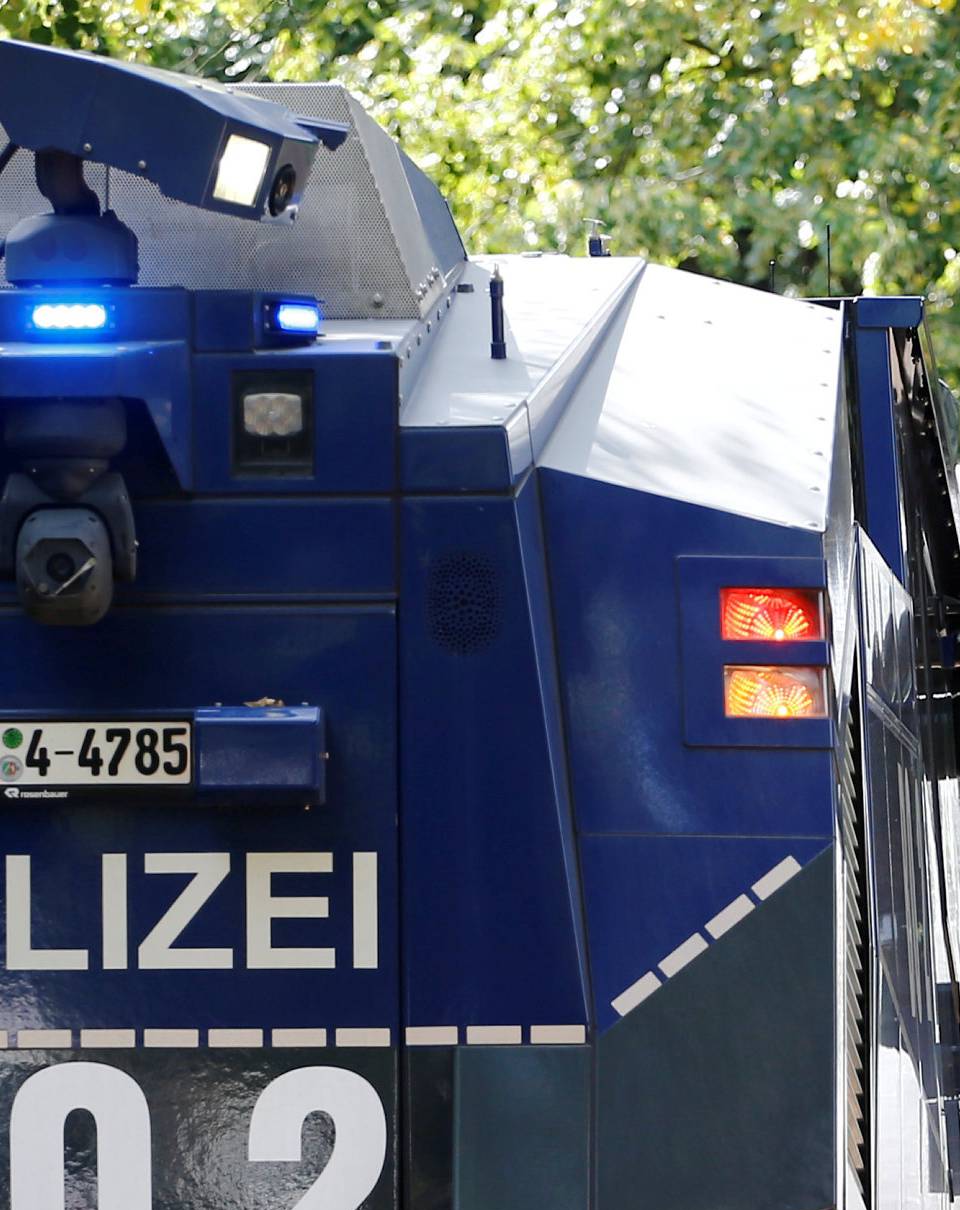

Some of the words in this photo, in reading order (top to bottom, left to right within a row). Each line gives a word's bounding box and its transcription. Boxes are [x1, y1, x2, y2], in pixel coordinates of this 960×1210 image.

[25, 727, 188, 777] 4-4785
[20, 789, 69, 799] rosenbauer
[5, 851, 378, 970] LIZEI
